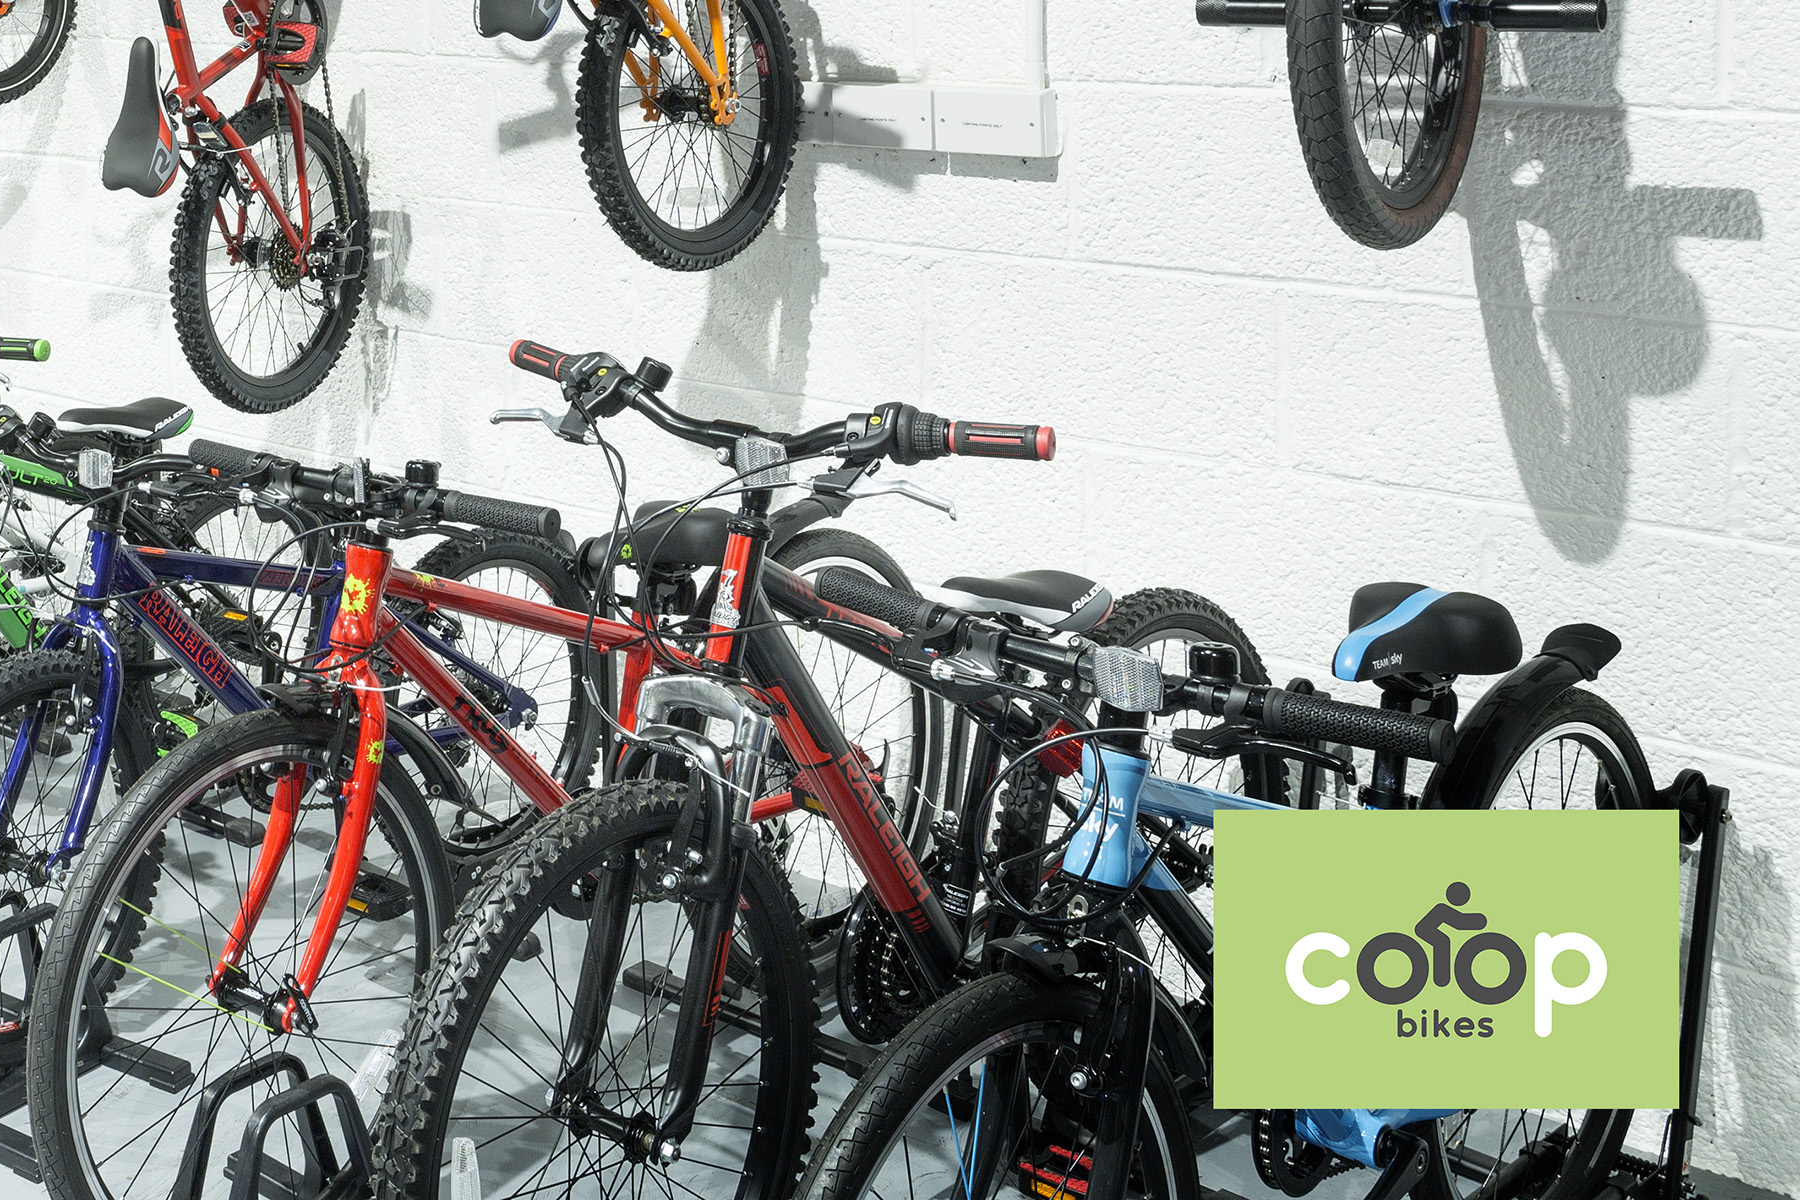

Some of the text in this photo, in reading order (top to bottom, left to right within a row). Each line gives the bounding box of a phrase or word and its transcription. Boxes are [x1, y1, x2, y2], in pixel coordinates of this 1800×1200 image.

[43, 475, 58, 486] 20
[1071, 583, 1104, 613] RALEI
[138, 582, 235, 690] RALEIGH
[1372, 652, 1403, 670] TEAM sky
[838, 750, 932, 903] RALEIGH
